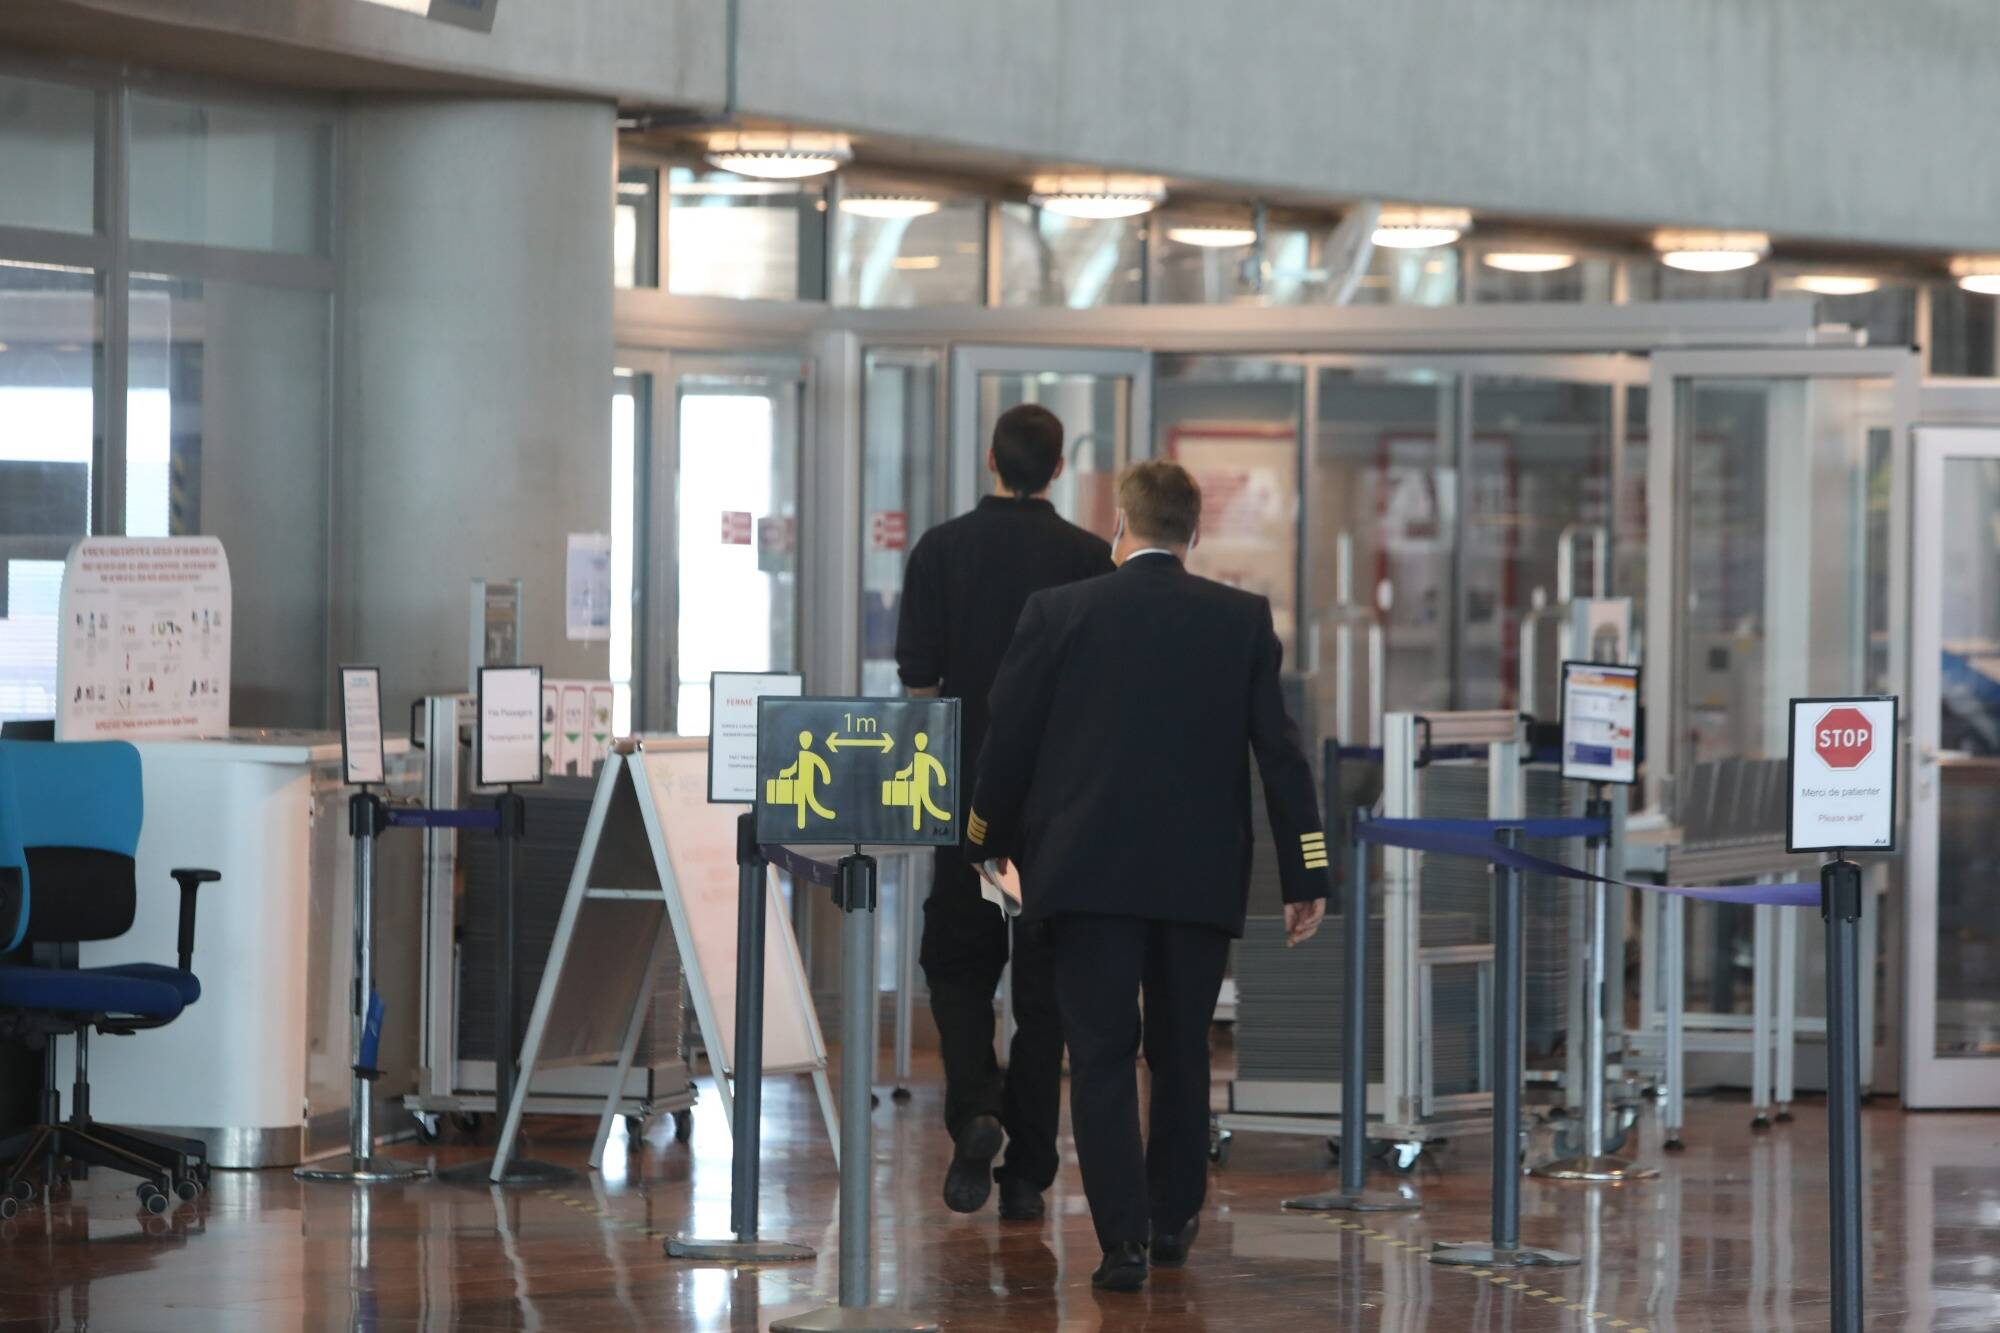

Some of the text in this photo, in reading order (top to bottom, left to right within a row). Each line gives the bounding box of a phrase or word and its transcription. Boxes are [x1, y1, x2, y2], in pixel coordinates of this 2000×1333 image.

[844, 712, 877, 733] 1m
[1819, 728, 1869, 748] STOP
[1801, 786, 1881, 797] Merci de patienter
[1818, 813, 1864, 823] Please wait
